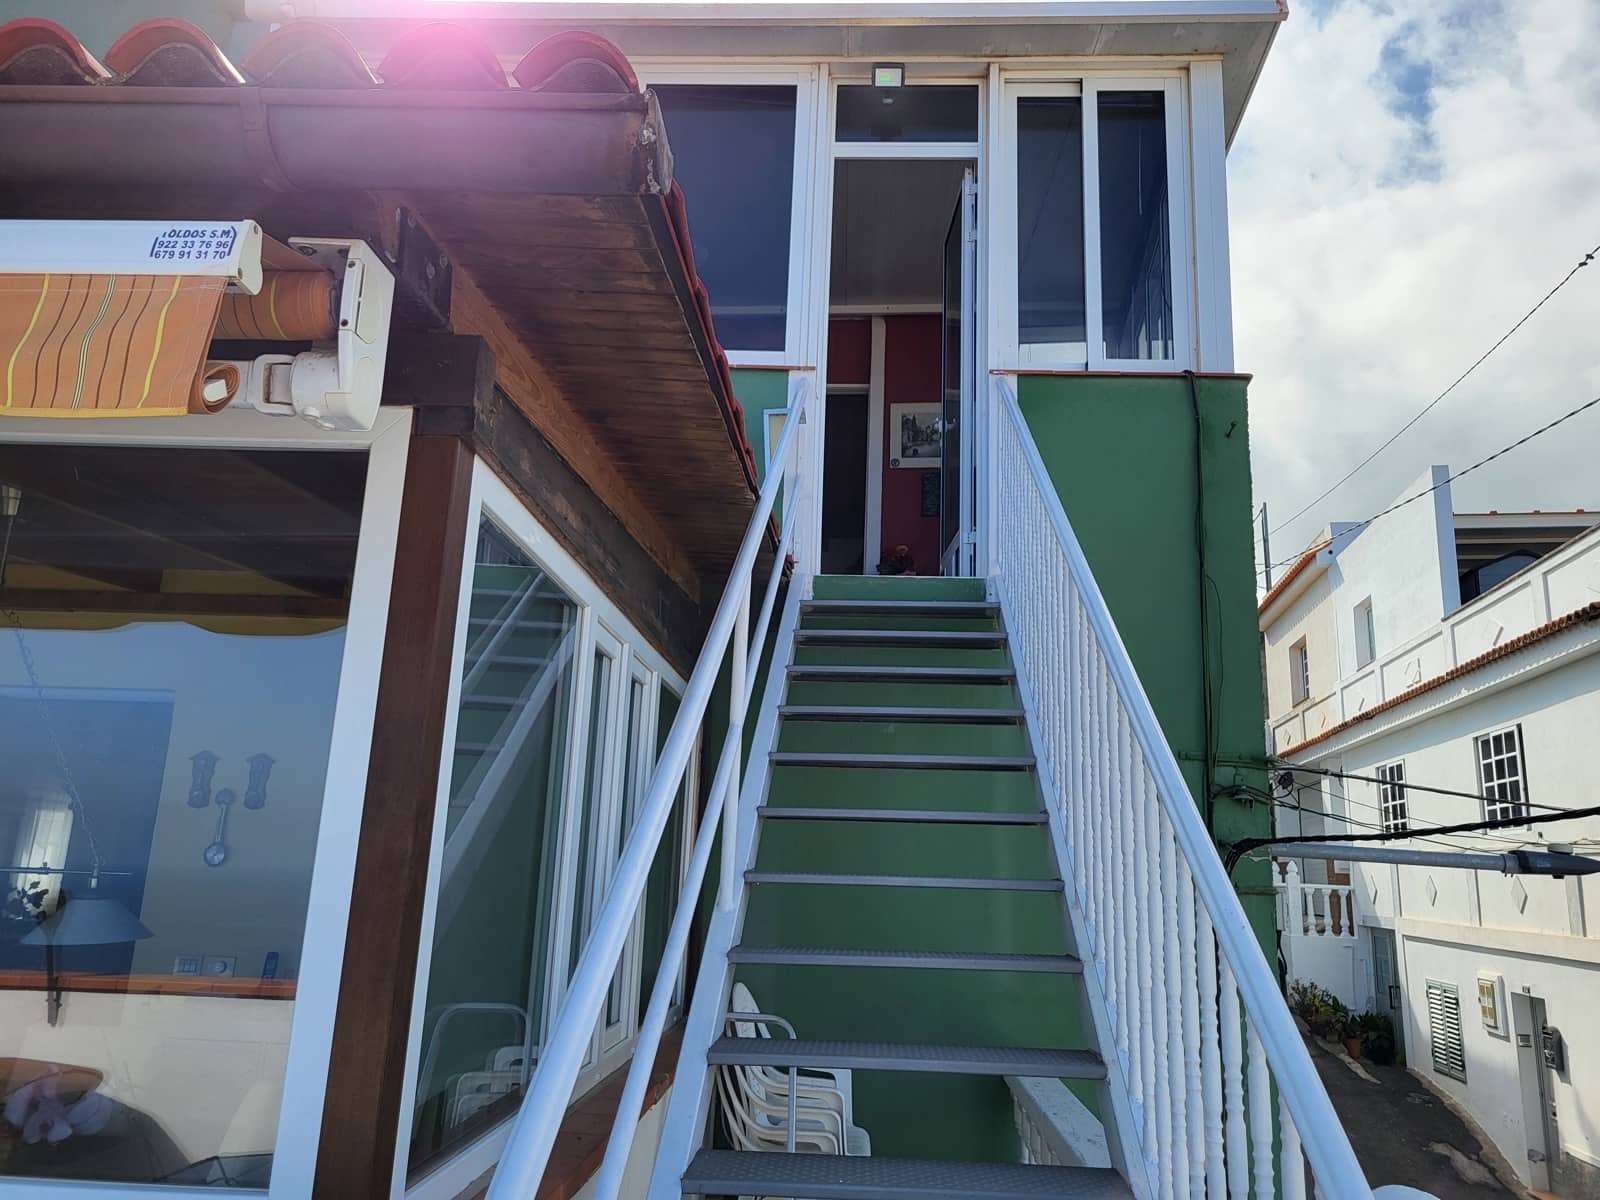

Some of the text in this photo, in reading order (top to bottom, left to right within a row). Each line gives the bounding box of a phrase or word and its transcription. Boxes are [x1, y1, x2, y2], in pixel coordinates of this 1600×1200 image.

[157, 240, 229, 249] 922 33 76 96
[154, 250, 226, 259] 679 91 31 70
